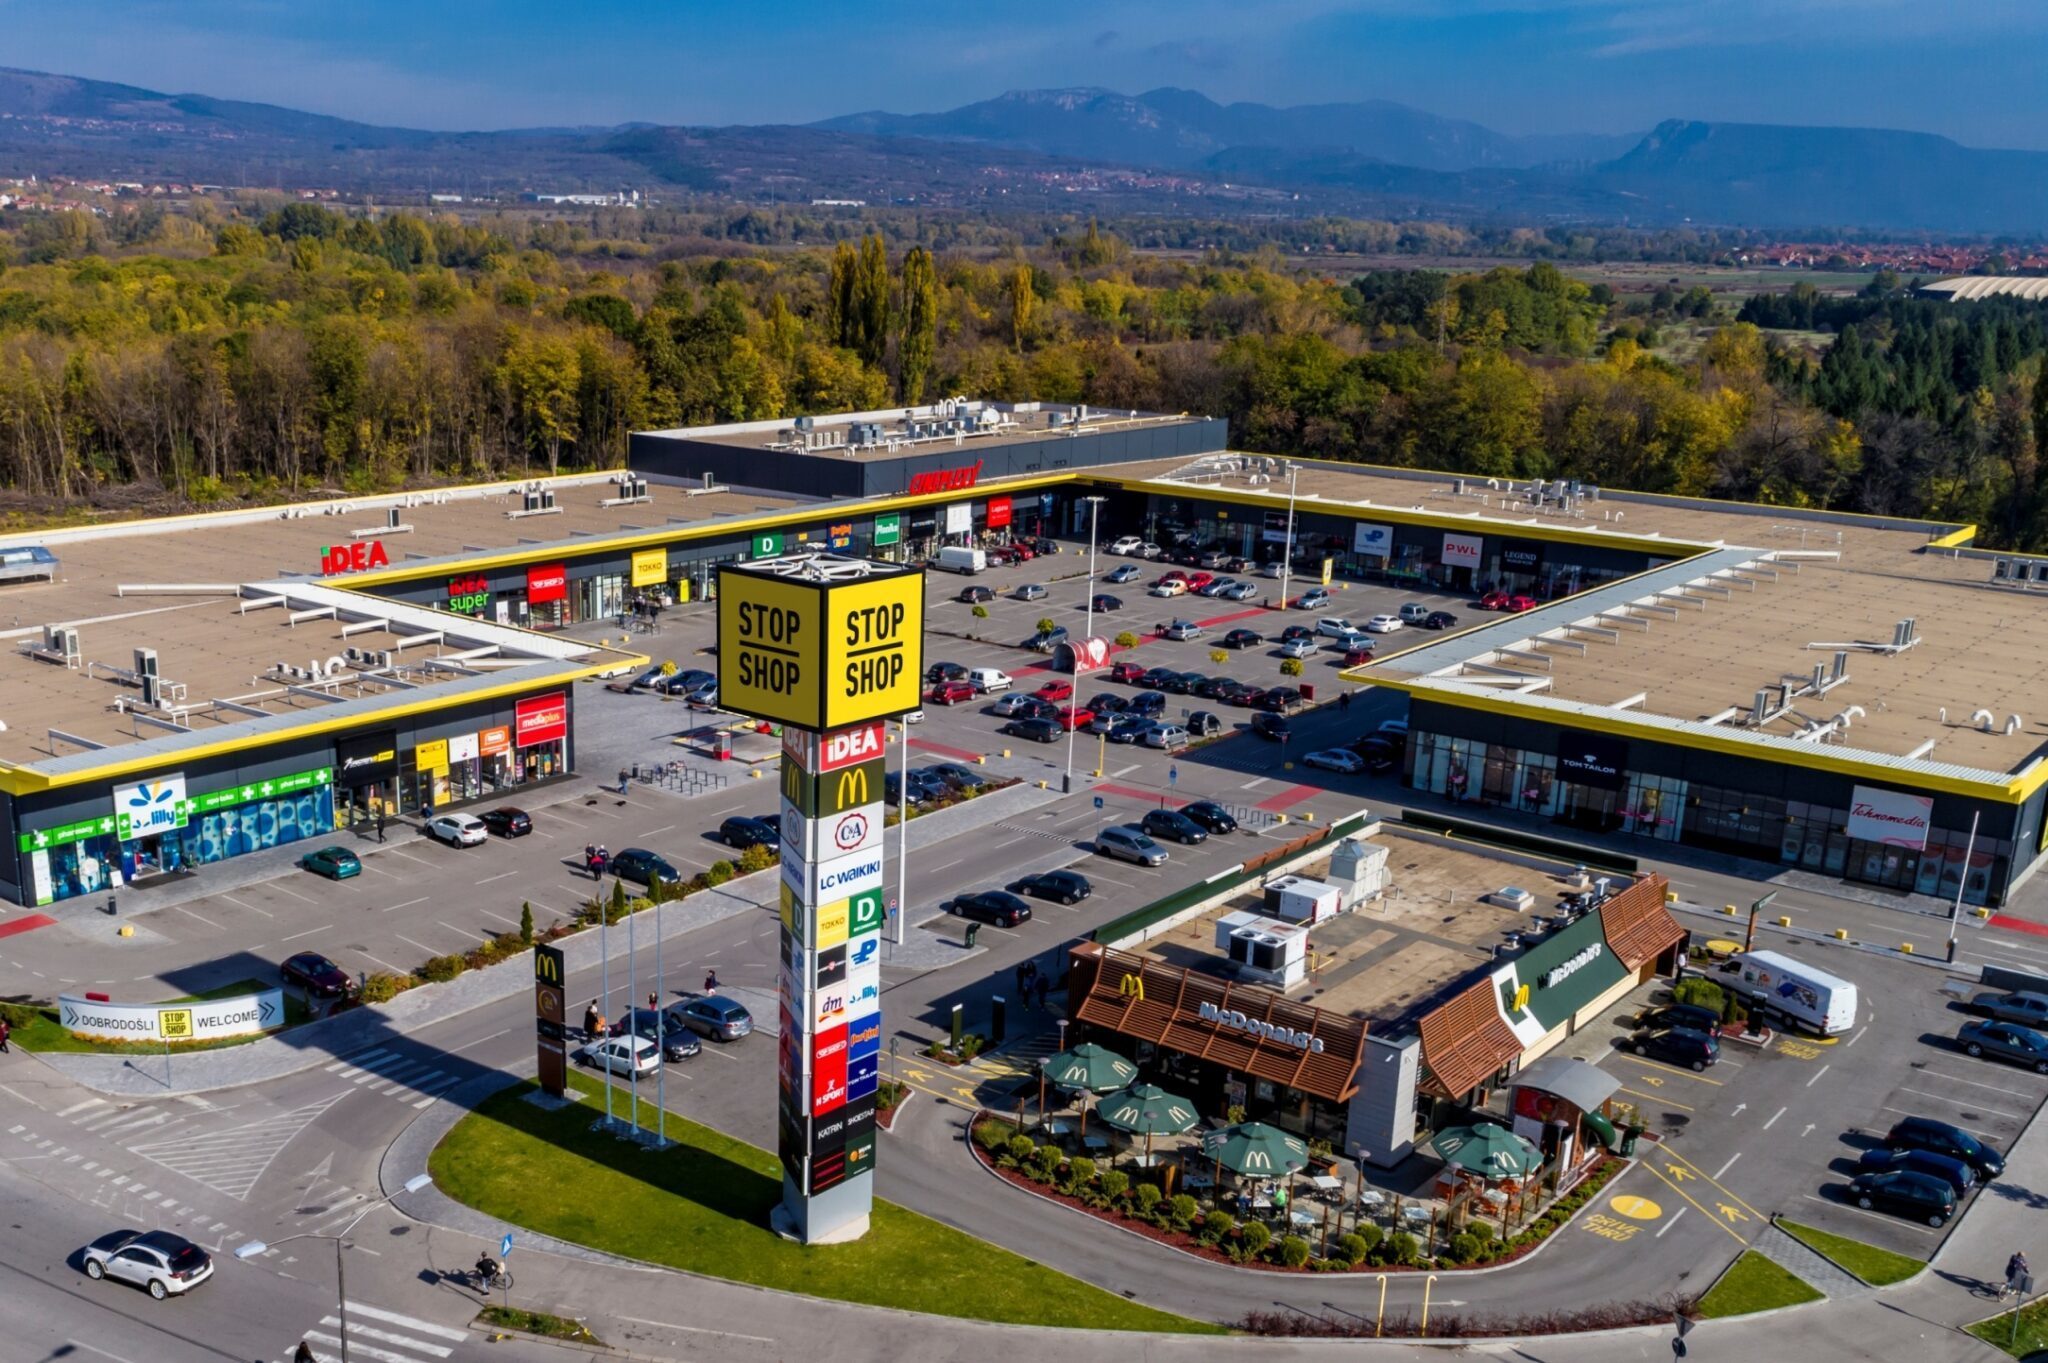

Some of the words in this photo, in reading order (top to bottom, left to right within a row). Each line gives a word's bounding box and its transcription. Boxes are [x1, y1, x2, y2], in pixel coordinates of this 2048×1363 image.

[1446, 543, 1478, 555] PWL
[1504, 550, 1537, 561] LEGEND
[449, 592, 489, 613] super
[739, 601, 800, 645] STOP
[846, 602, 904, 646] STOP
[739, 651, 800, 696] SHOP
[845, 653, 903, 697] SHOP
[1562, 759, 1583, 769] TOM
[1584, 762, 1616, 775] TAILOR
[151, 809, 175, 826] lilly
[820, 875, 835, 890] LC
[857, 897, 875, 922] D
[1549, 943, 1601, 988] McDonald's
[862, 985, 877, 999] lilly
[822, 996, 842, 1013] dm
[81, 1015, 154, 1031] DOBRODOŠLI
[164, 1012, 185, 1023] STOP
[197, 1010, 258, 1028] WELCOME
[165, 1025, 186, 1035] SHOP
[1199, 1001, 1324, 1053] McDonald's
[822, 1087, 845, 1103] SPORT
[847, 1108, 874, 1125] SHOESTAR
[818, 1121, 843, 1140] KATRIN
[1586, 1214, 1645, 1232] DRIVE
